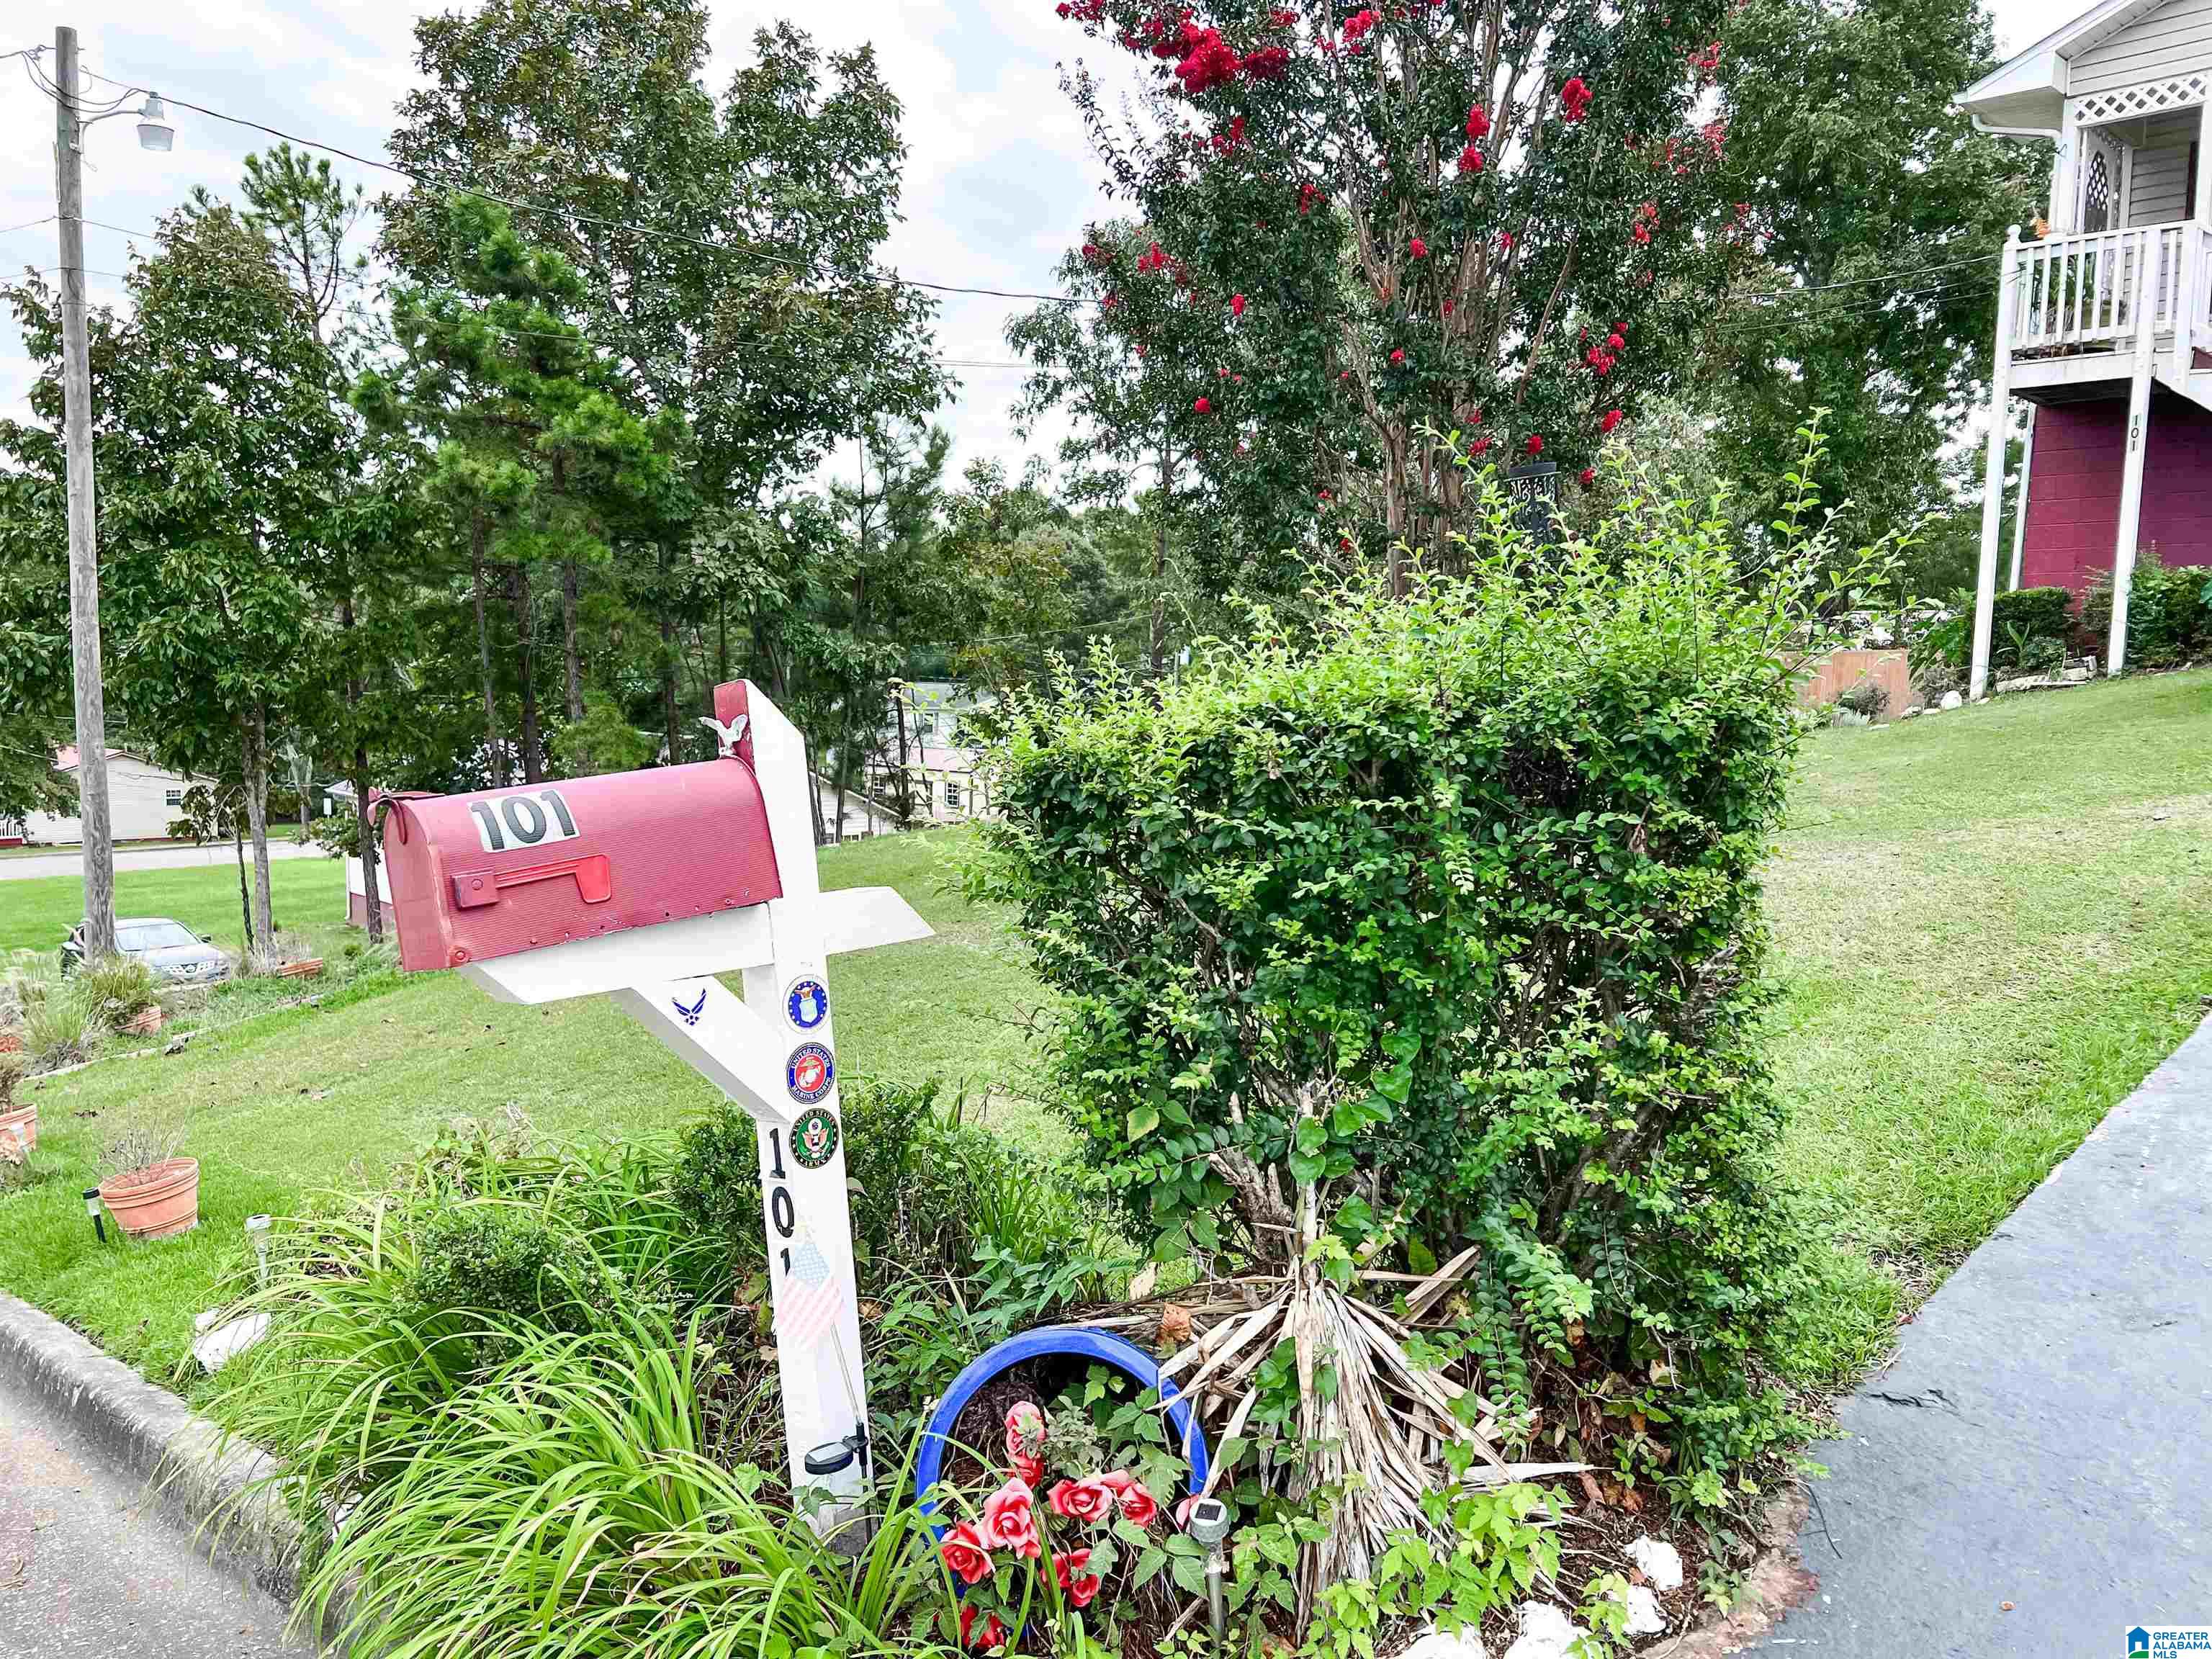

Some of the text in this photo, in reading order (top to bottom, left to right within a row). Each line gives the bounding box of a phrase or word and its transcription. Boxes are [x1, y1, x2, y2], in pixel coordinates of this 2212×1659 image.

[471, 790, 576, 850] 101
[791, 1048, 832, 1069] UNITED STATES
[792, 1077, 832, 1100] MARINE CORPS
